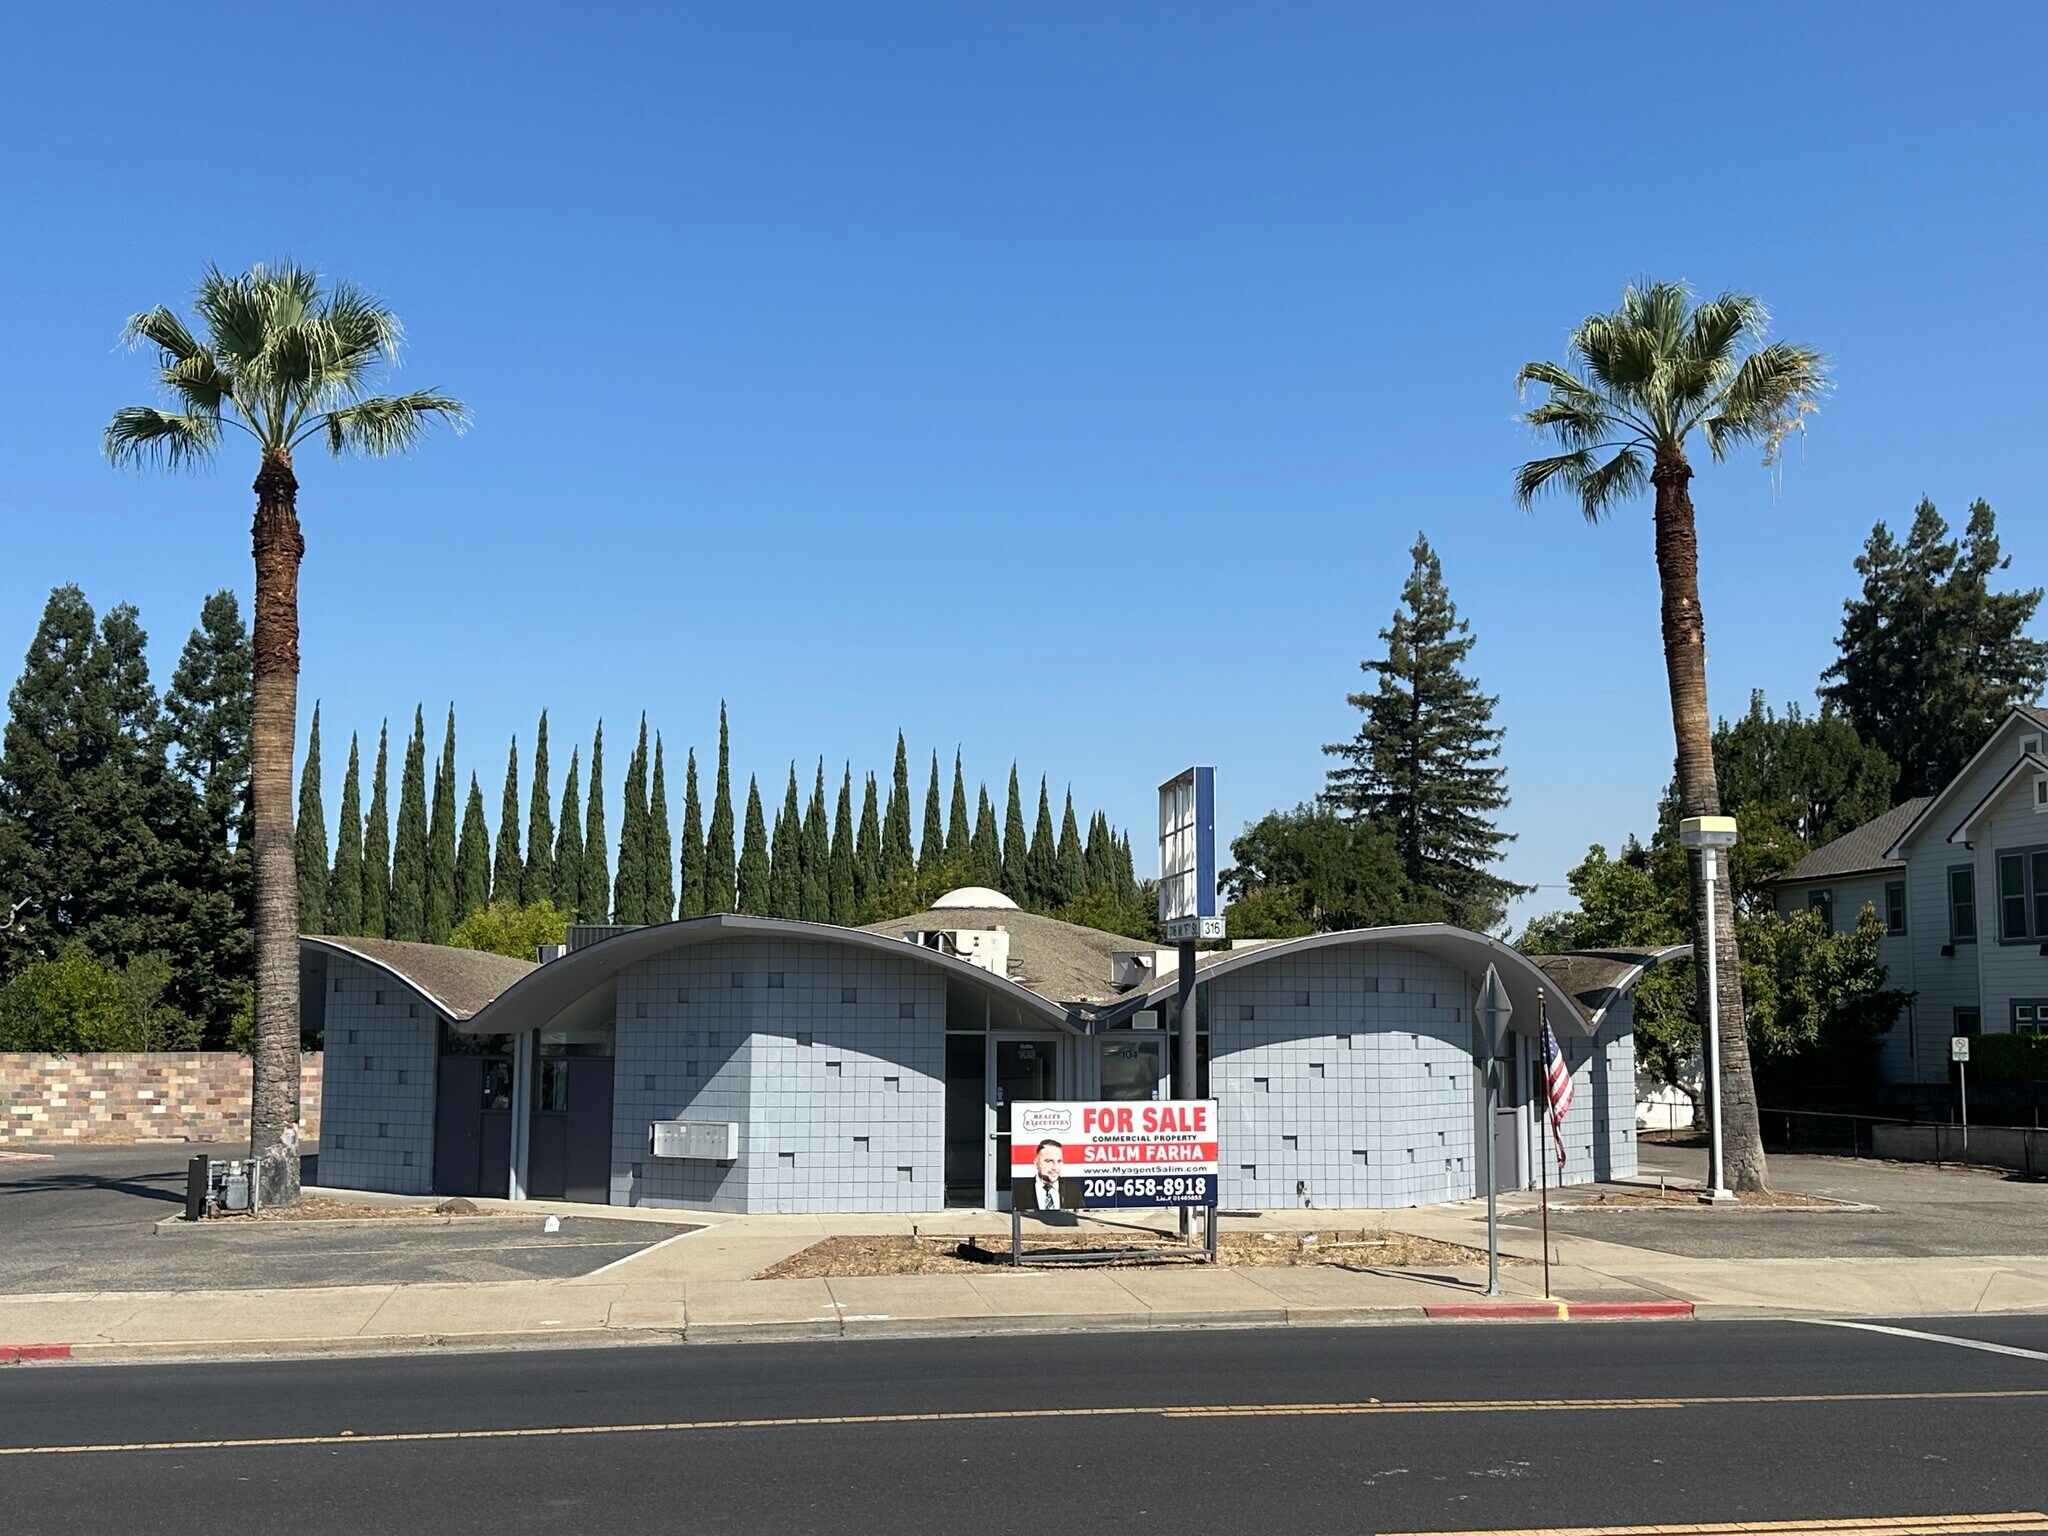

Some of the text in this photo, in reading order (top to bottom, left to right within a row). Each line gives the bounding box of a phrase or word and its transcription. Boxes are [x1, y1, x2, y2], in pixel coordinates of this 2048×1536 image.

[1205, 922, 1220, 935] 316
[1122, 1050, 1138, 1059] 104
[1025, 1119, 1069, 1127] EXECUTIVES
[1083, 1107, 1206, 1133] FOR SALE
[1154, 1134, 1197, 1142] PROPERTY
[1084, 1144, 1204, 1162] SALIM FARHA
[1083, 1165, 1208, 1175] www.MyagentSalim.com
[1083, 1177, 1206, 1197] 209-658-8918
